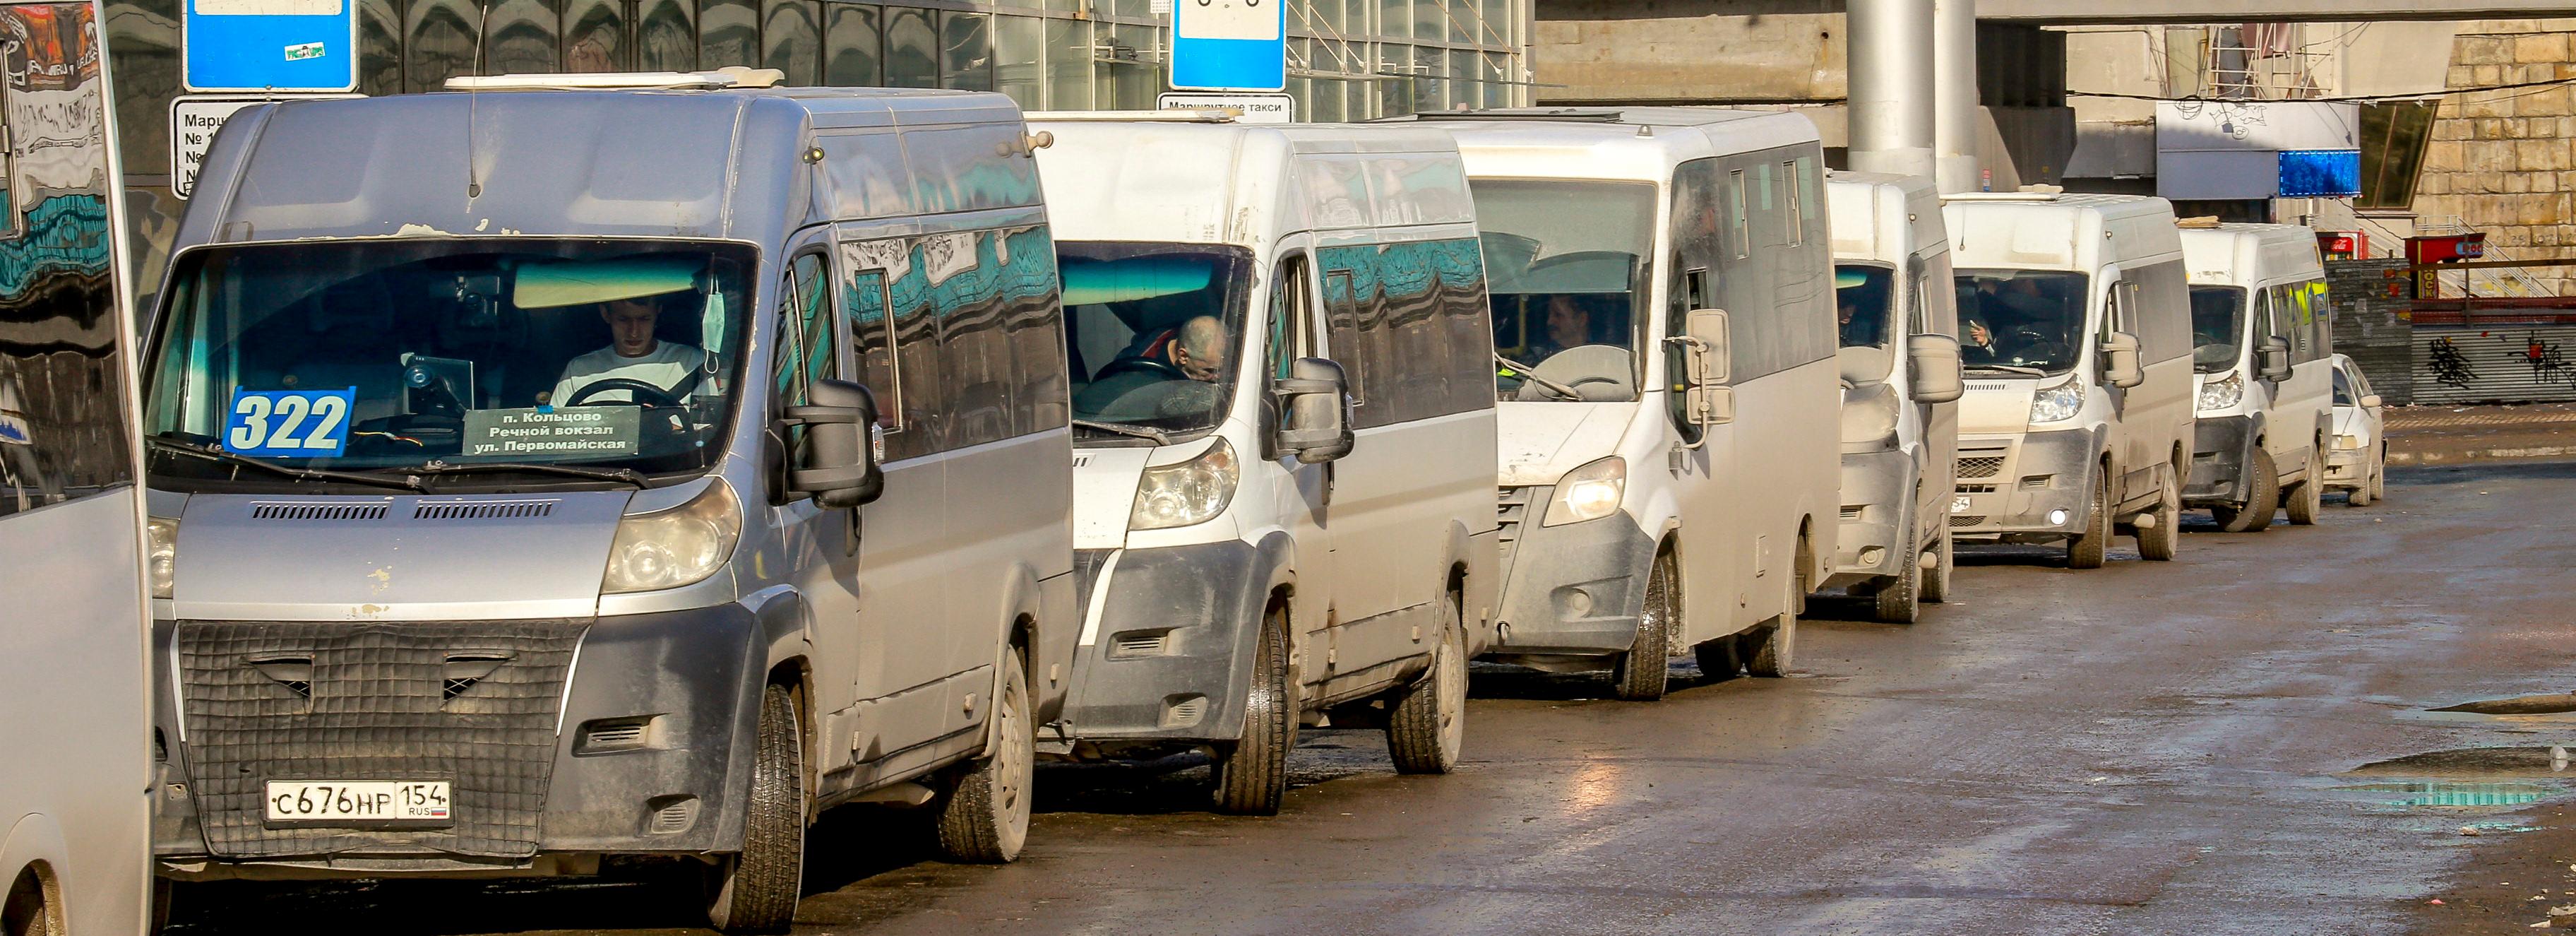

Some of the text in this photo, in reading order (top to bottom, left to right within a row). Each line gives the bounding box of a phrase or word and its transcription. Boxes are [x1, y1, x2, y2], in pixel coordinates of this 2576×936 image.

[185, 132, 202, 145] №
[2423, 270, 2435, 297] OCK
[230, 395, 347, 449] 322
[503, 412, 602, 424] п. Кольцово
[489, 425, 614, 437] Речной вокзал
[474, 438, 626, 455] ул. Первомайская
[400, 785, 443, 806] 154
[409, 807, 430, 816] RUS
